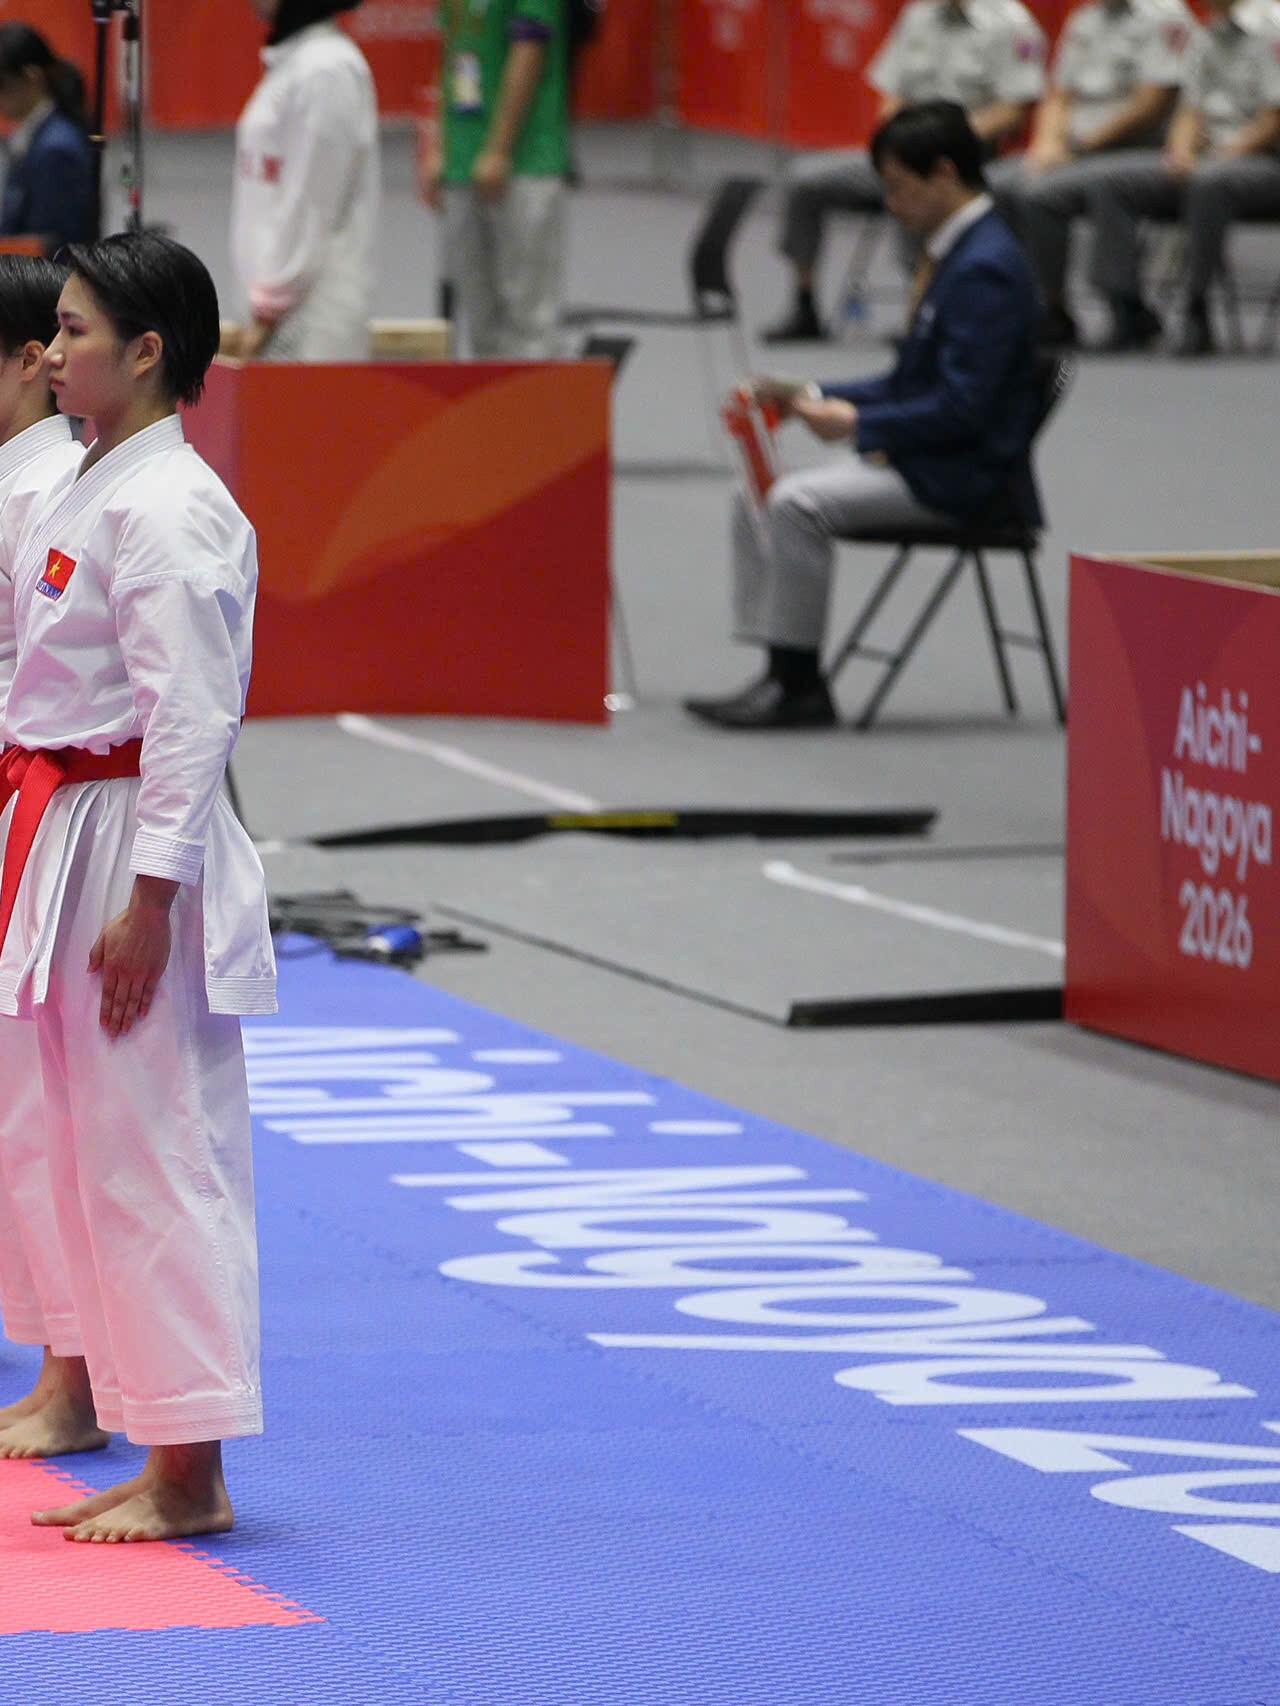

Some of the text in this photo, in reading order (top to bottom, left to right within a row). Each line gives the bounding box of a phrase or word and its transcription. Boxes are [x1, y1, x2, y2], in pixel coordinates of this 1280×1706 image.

[1174, 680, 1262, 773] Aichi-
[1161, 766, 1272, 880] Nagoya
[1180, 878, 1253, 969] 2026
